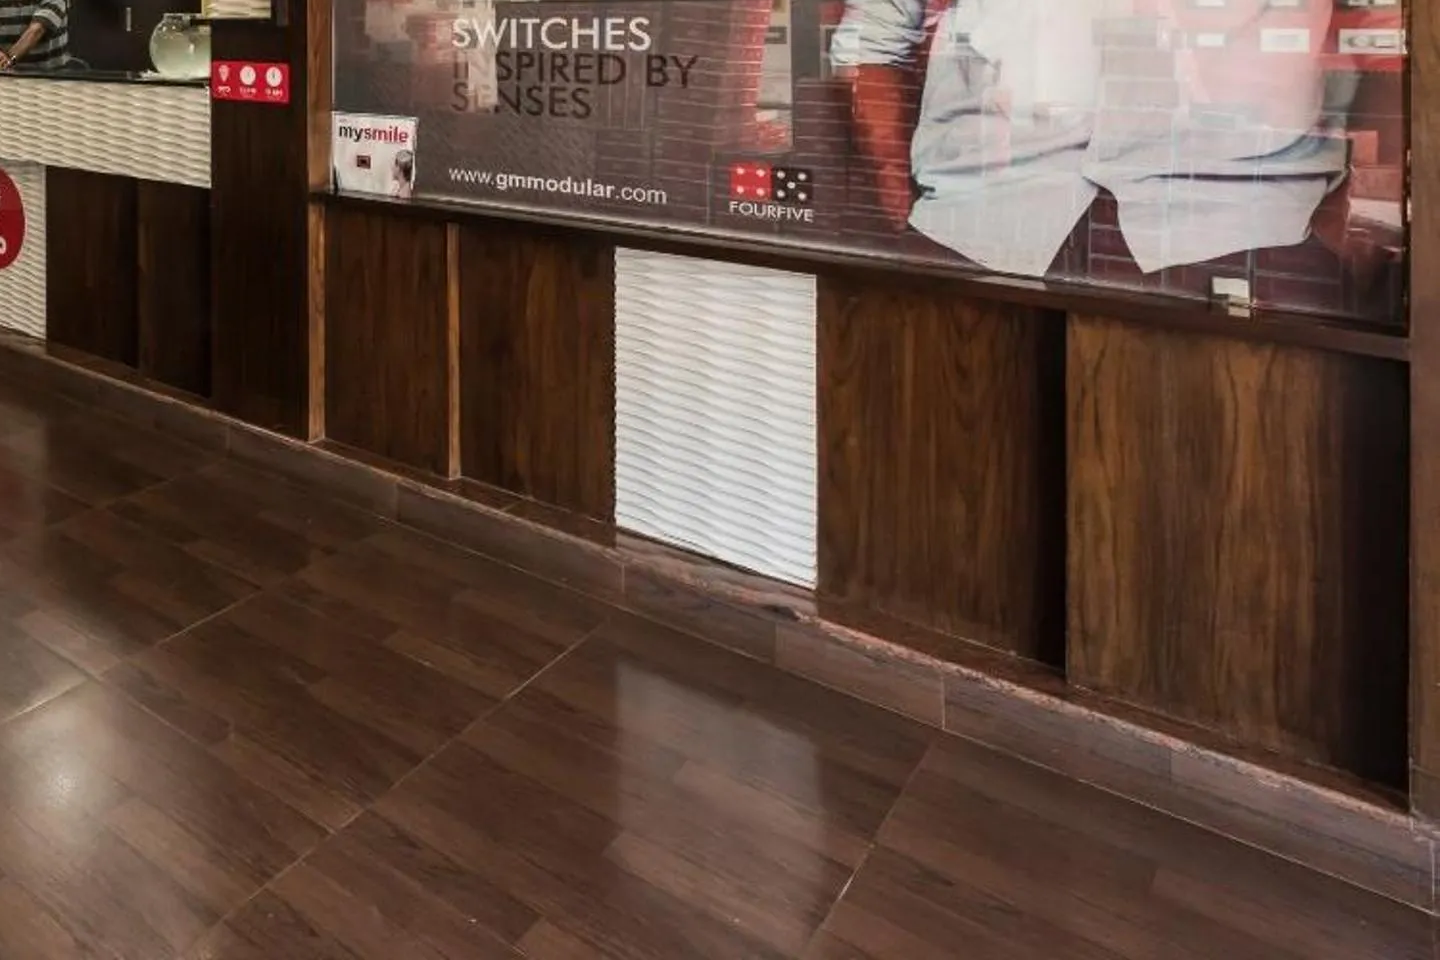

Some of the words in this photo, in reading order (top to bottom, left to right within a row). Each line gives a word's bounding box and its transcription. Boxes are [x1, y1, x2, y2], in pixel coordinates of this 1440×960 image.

[451, 17, 652, 52] SWITCHES
[453, 50, 627, 86] INSPIRED
[646, 54, 699, 89] BY
[451, 82, 592, 119] SENSES
[338, 125, 409, 143] mysmile
[448, 166, 668, 205] www.gmmodular.com
[729, 201, 814, 223] FOURFIVE
